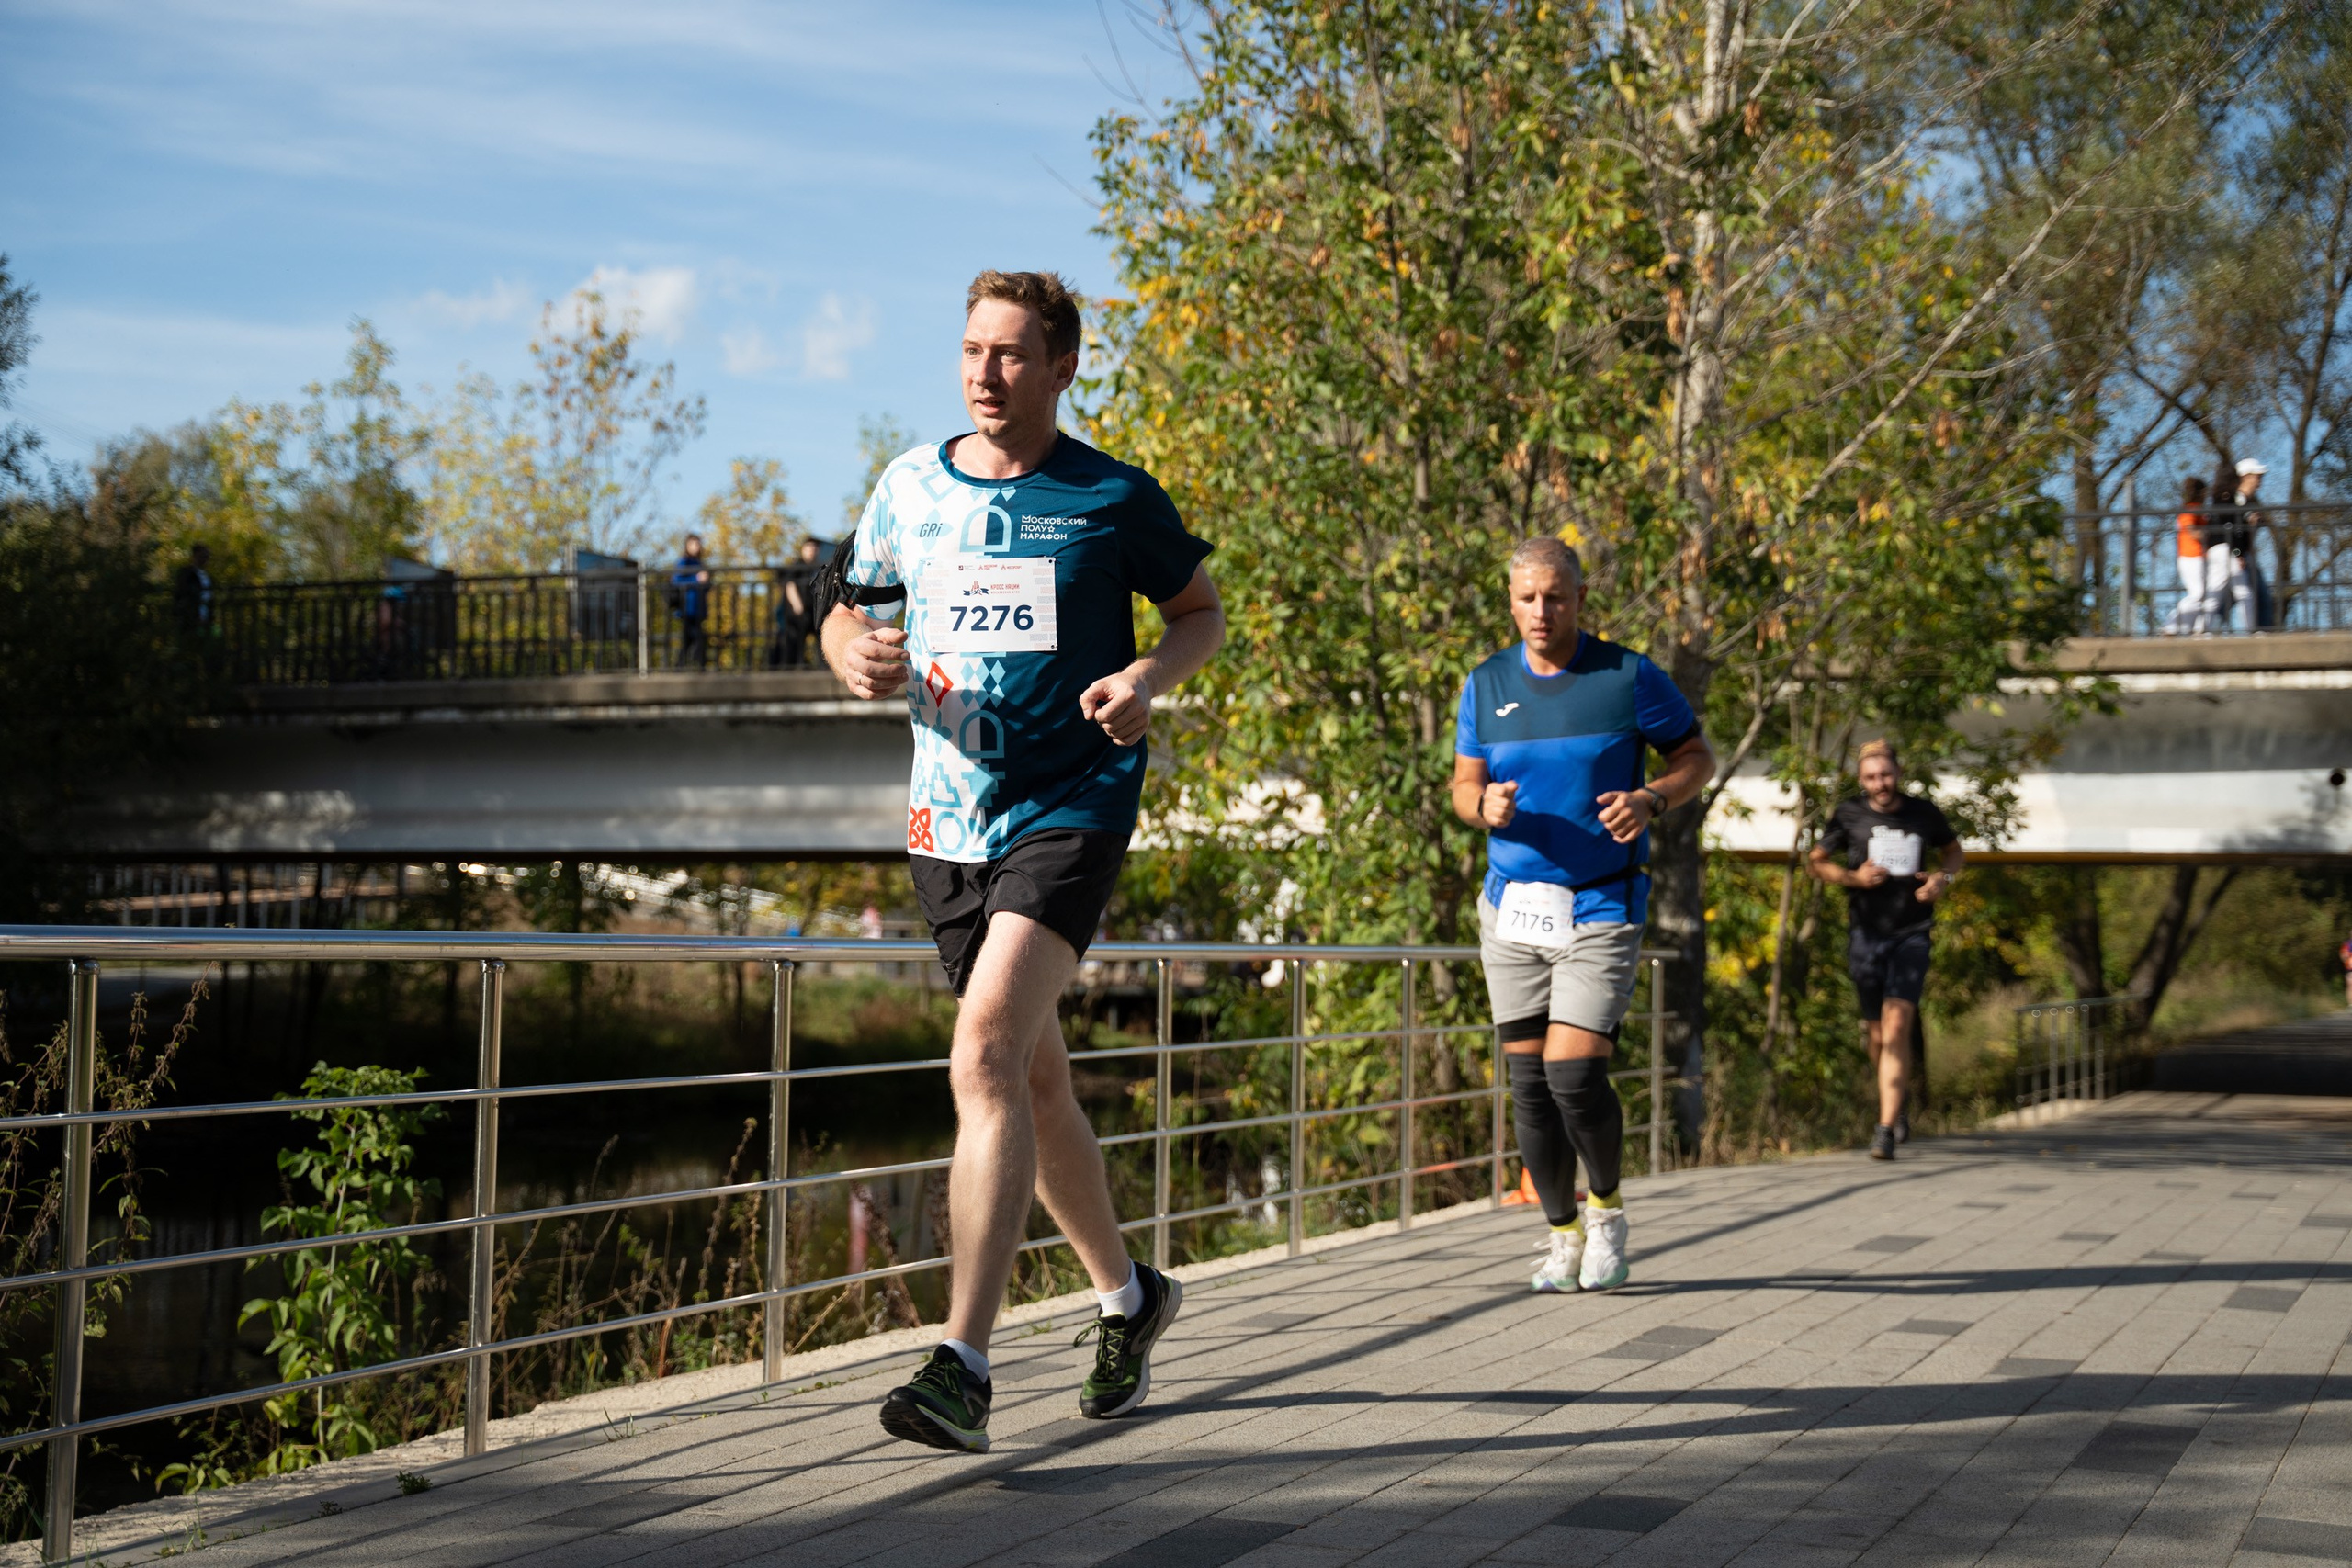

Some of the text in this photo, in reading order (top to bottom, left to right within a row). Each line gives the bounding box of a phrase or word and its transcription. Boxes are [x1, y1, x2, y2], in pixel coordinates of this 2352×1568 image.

[1020, 525, 1047, 533] ПОЛУ
[950, 604, 1034, 631] 7276
[1511, 910, 1554, 932] 7176
